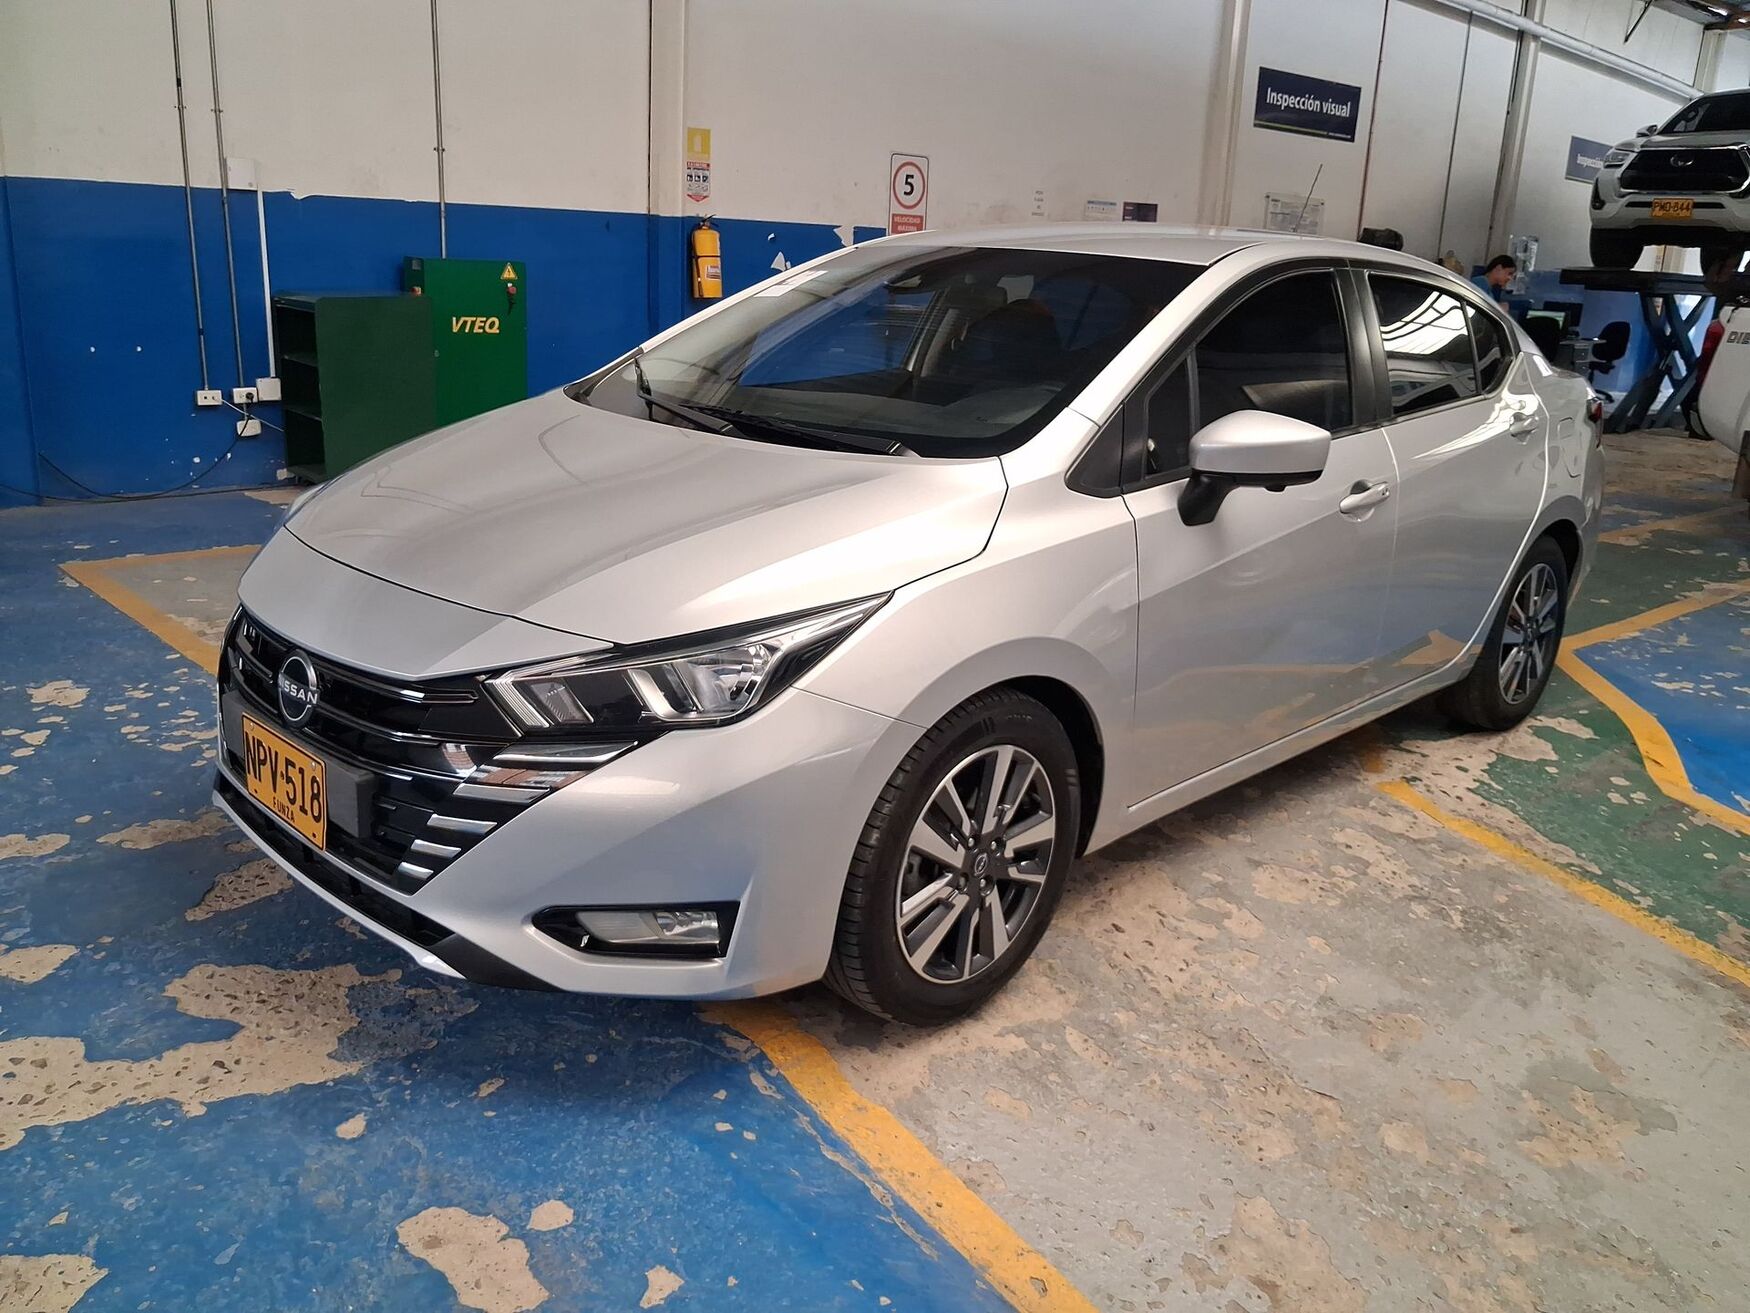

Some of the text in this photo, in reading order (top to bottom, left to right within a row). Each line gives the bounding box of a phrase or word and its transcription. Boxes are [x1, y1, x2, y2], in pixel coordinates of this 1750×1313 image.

[1266, 87, 1351, 117] Inspección visual
[903, 174, 915, 196] 5
[451, 316, 500, 334] VTEQ
[278, 671, 318, 705] NISSAN
[273, 796, 295, 823] FUNZA
